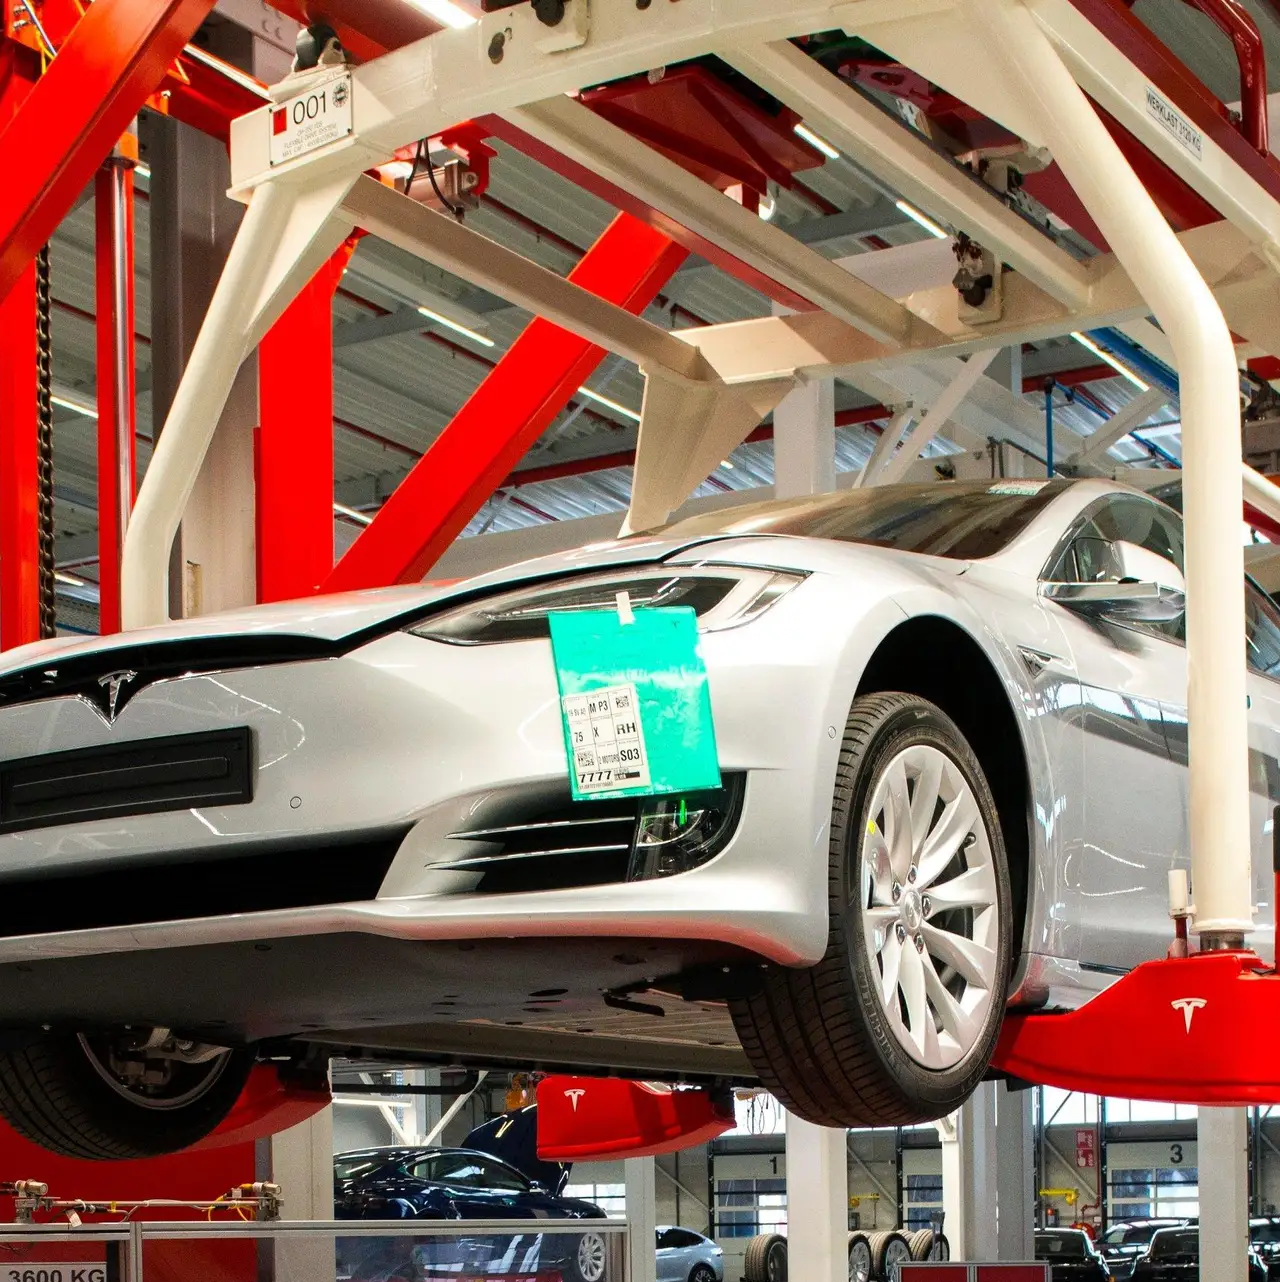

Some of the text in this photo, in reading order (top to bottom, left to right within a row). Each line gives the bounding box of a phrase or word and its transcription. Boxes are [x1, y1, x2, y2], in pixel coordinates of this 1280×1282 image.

[293, 91, 326, 125] 001
[598, 700, 608, 712] P3
[593, 726, 600, 738] X
[616, 722, 636, 735] RH
[574, 731, 584, 743] 75
[578, 770, 612, 784] 7777
[1170, 1144, 1183, 1164] 3
[769, 1156, 777, 1174] 1
